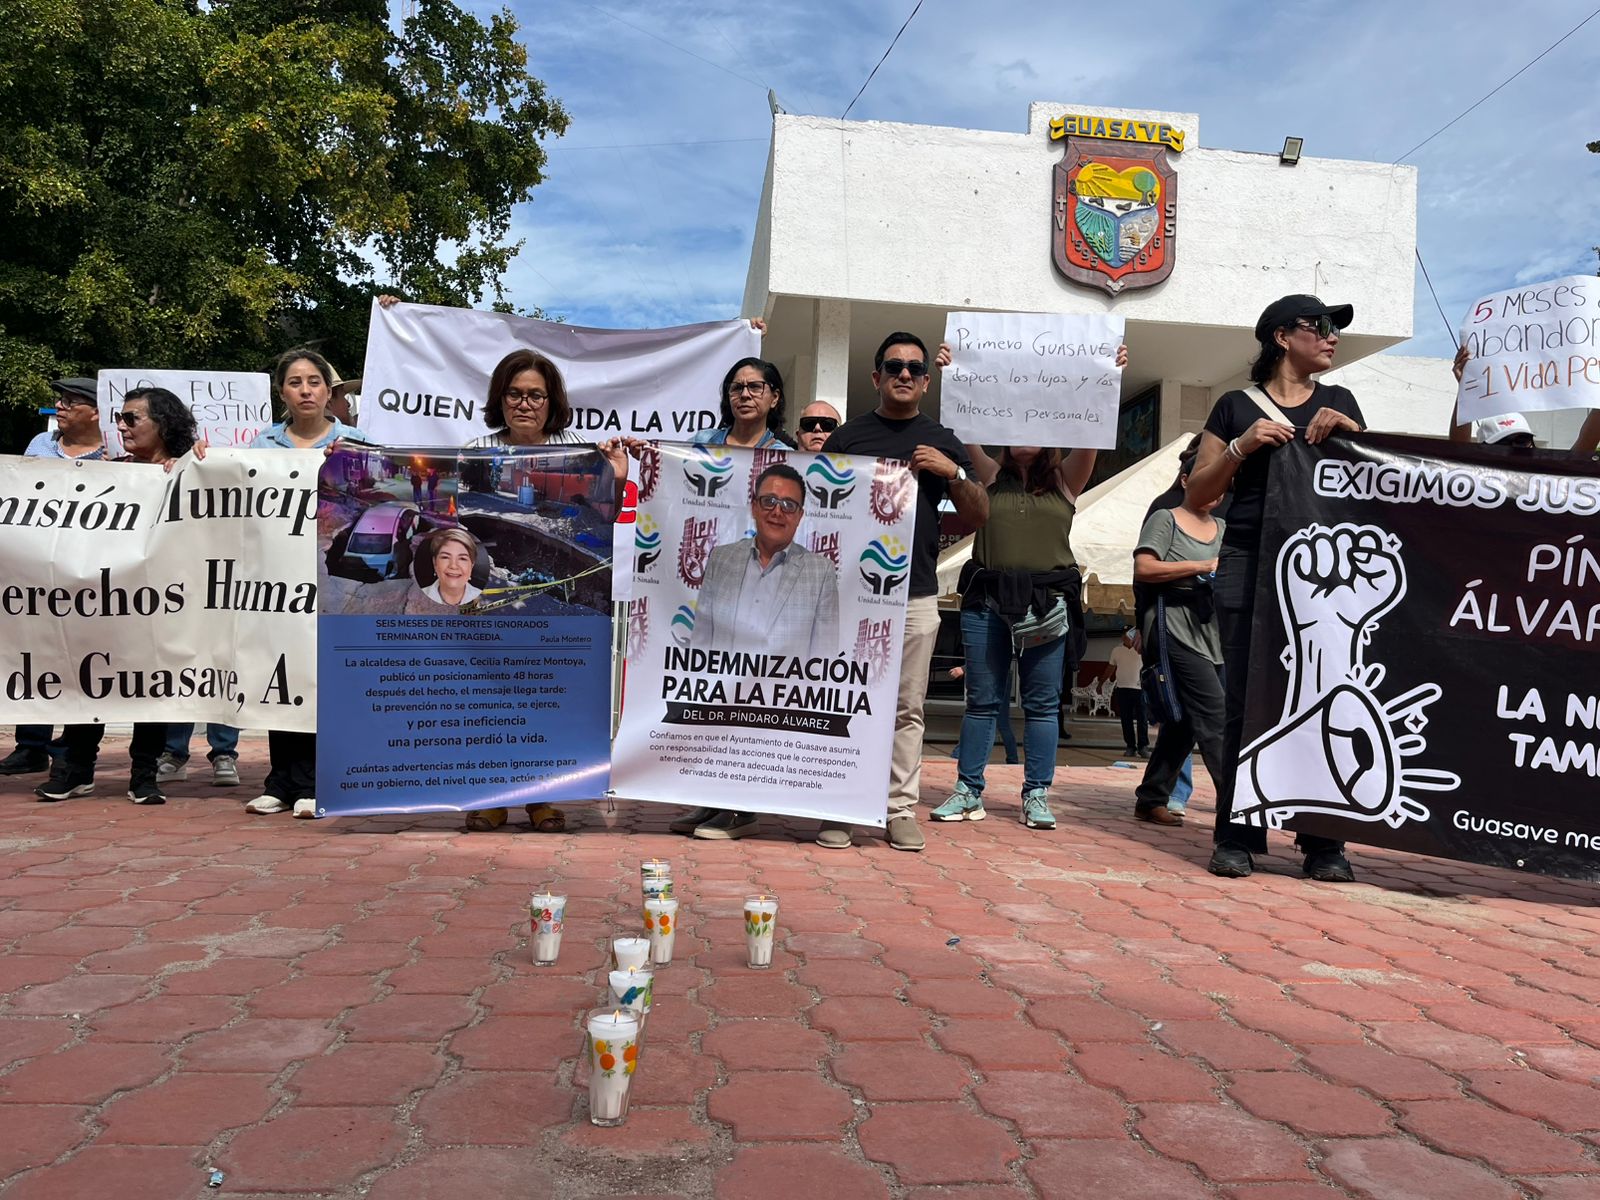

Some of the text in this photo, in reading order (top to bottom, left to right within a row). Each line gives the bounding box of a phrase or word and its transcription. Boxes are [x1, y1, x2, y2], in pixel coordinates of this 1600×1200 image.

[1064, 117, 1171, 141] GUASAVE
[1473, 299, 1493, 323] 5
[957, 328, 1022, 351] Primero
[1010, 368, 1028, 383] los
[1038, 370, 1067, 387] lujos
[1075, 377, 1088, 390] y
[1504, 360, 1560, 391] Vida
[1568, 355, 1600, 386] Pe
[188, 380, 244, 401] FUE
[378, 388, 474, 421] QUIEN
[631, 410, 663, 432] LA
[1314, 457, 1506, 508] EXIGIMOS
[694, 517, 718, 539] IPN
[815, 531, 839, 553] IPN
[2, 559, 317, 617] erechos Huma
[858, 596, 905, 607] Unidad Sinaloa
[376, 619, 396, 627] SEIS
[446, 620, 492, 628] REPORTES
[494, 620, 549, 628] IGNORADOS
[867, 619, 891, 640] IPN
[376, 632, 438, 640] TERMINARON
[540, 635, 560, 643] Paula
[561, 635, 592, 643] Montero
[345, 656, 586, 667] La alcaldesa de Guasave, Cecilia Ramírez Montoya,
[664, 646, 869, 685] INDEMNIZACIÓN
[6, 652, 303, 712] de Guasave, A.
[380, 671, 415, 683] publicó
[433, 671, 510, 682] posicionamiento
[513, 671, 525, 680] 48
[528, 671, 554, 680] horas
[366, 685, 567, 698] después del hecho, el mensaje llega tarde:
[662, 676, 872, 716] PARA LA FAMILIA
[372, 703, 381, 712] la
[384, 701, 437, 713] prevención
[468, 701, 515, 710] comunica,
[530, 700, 560, 709] ejerce,
[1497, 685, 1600, 730] LA N
[407, 715, 526, 730] y por esa ineficiencia
[682, 709, 830, 730] DEL DR. PÍNDARO ÁLVAREZ
[387, 733, 548, 749] una persona perdió la vida.
[649, 730, 691, 741] Confiamos
[730, 735, 782, 747] Ayuntamiento
[783, 740, 793, 748] de
[795, 741, 828, 752] Guasave
[829, 746, 861, 756] asumirá
[666, 744, 728, 754] responsabilidad
[729, 746, 740, 755] las
[741, 749, 776, 759] acciones
[793, 754, 800, 762] le
[801, 756, 858, 769] corresponden,
[1508, 732, 1600, 777] TAM
[346, 759, 577, 776] ¿cuántas advertencias más deben ignorarse para
[660, 755, 846, 780] atendiendo de manera adecuada las necesidades
[679, 767, 824, 790] derivadas de esta pérdida irreparable.
[340, 781, 359, 791] que
[376, 778, 423, 789] gobierno,
[425, 777, 440, 786] del
[443, 776, 466, 785] nivel
[469, 777, 487, 786] que
[489, 776, 507, 784] sea,
[510, 773, 535, 783] actúe
[1453, 810, 1558, 843] Guasave
